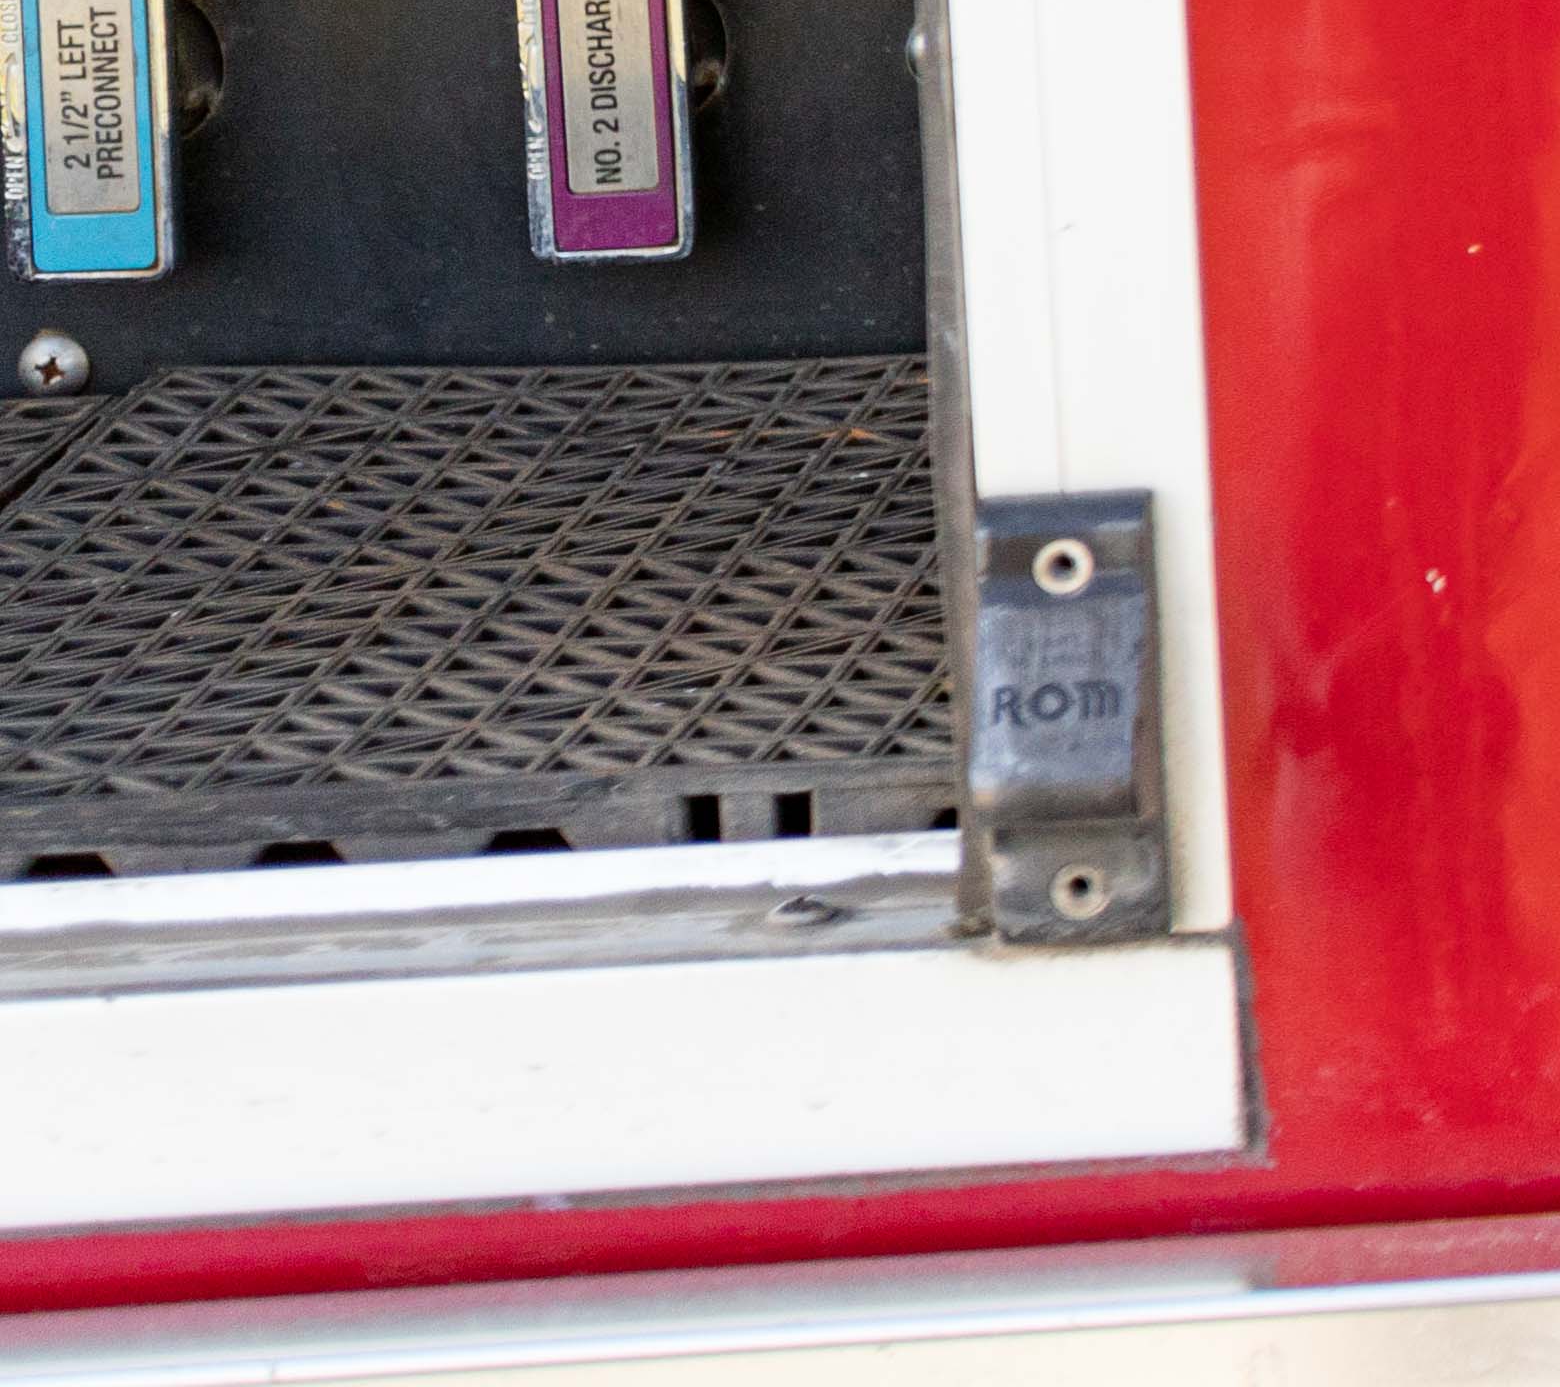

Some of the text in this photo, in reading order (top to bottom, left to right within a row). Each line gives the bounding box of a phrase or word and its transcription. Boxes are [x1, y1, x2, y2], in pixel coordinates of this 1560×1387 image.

[58, 20, 87, 82] LEFT
[89, 7, 124, 181] PRECONNECT
[593, 118, 620, 134] 2
[64, 152, 91, 170] 2
[595, 141, 622, 185] NO.
[991, 679, 1121, 728] ROM
